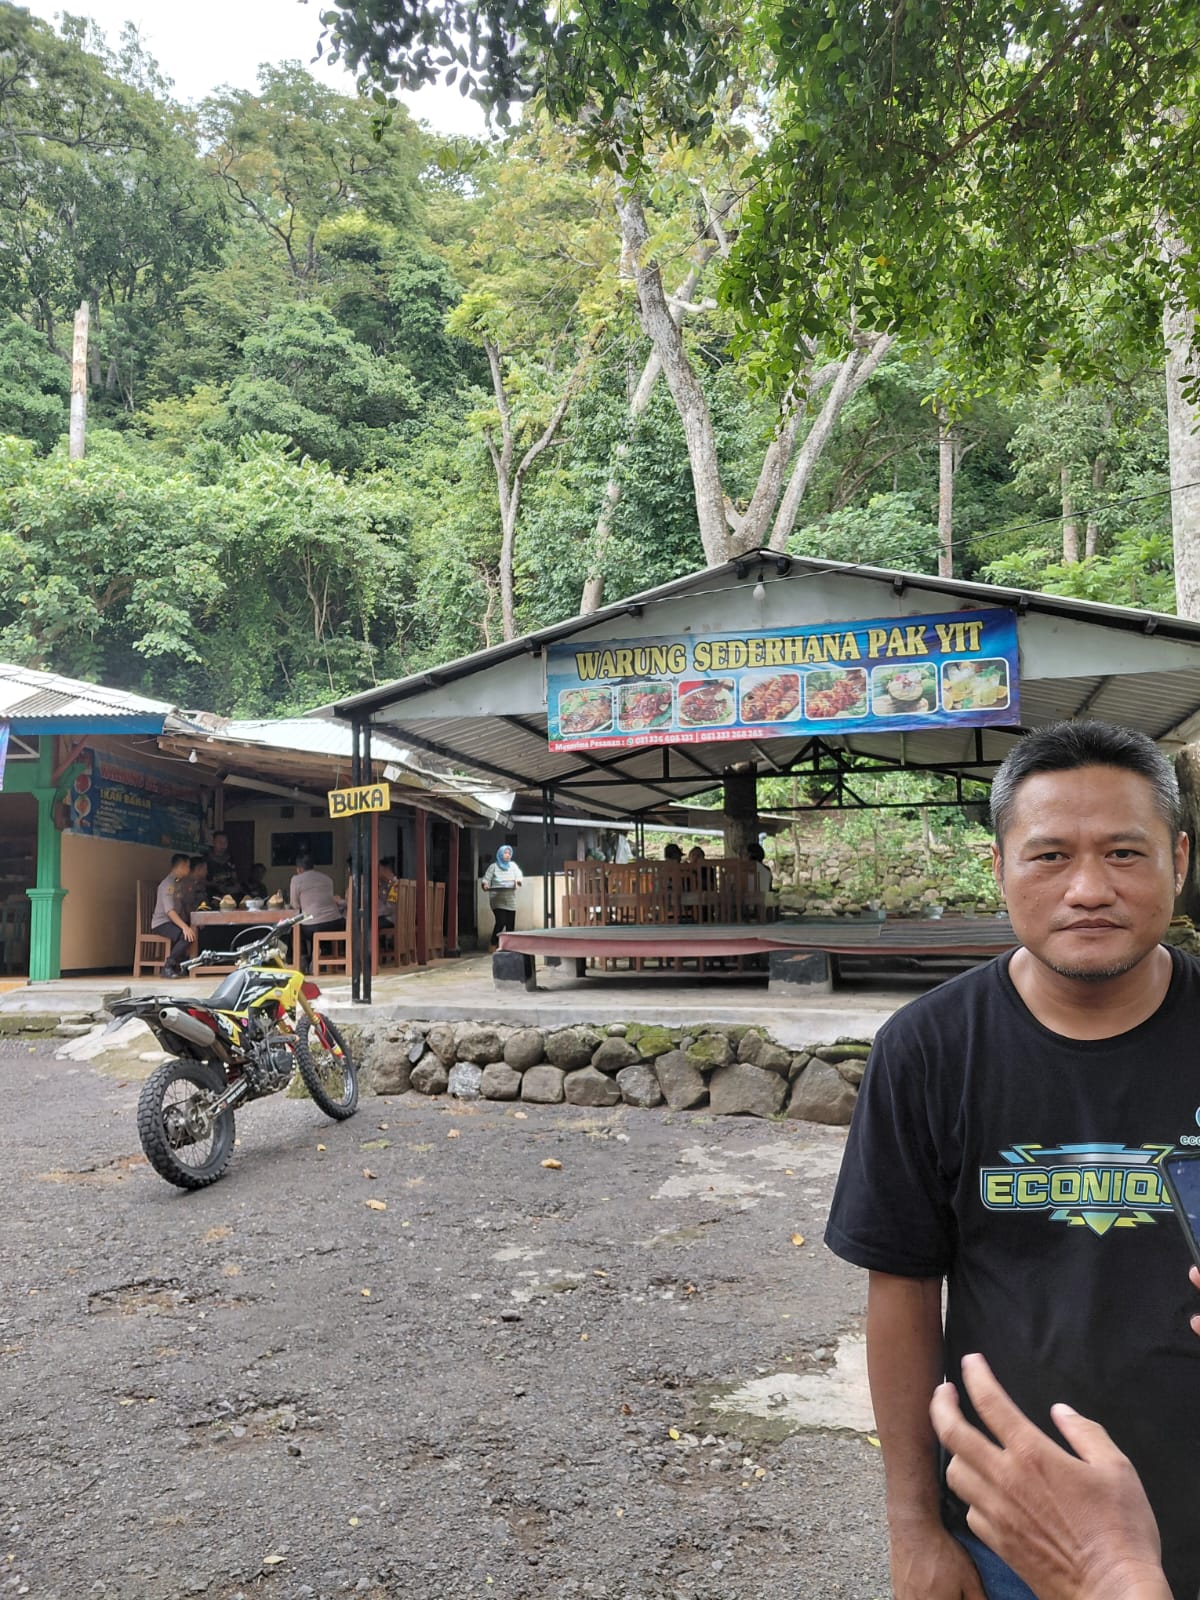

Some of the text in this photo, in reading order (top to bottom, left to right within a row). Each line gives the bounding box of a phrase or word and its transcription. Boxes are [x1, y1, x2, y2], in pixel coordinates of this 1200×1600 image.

[576, 620, 984, 681] WARUNG SEDERHANA PAK YIT
[330, 788, 384, 814] BUKA
